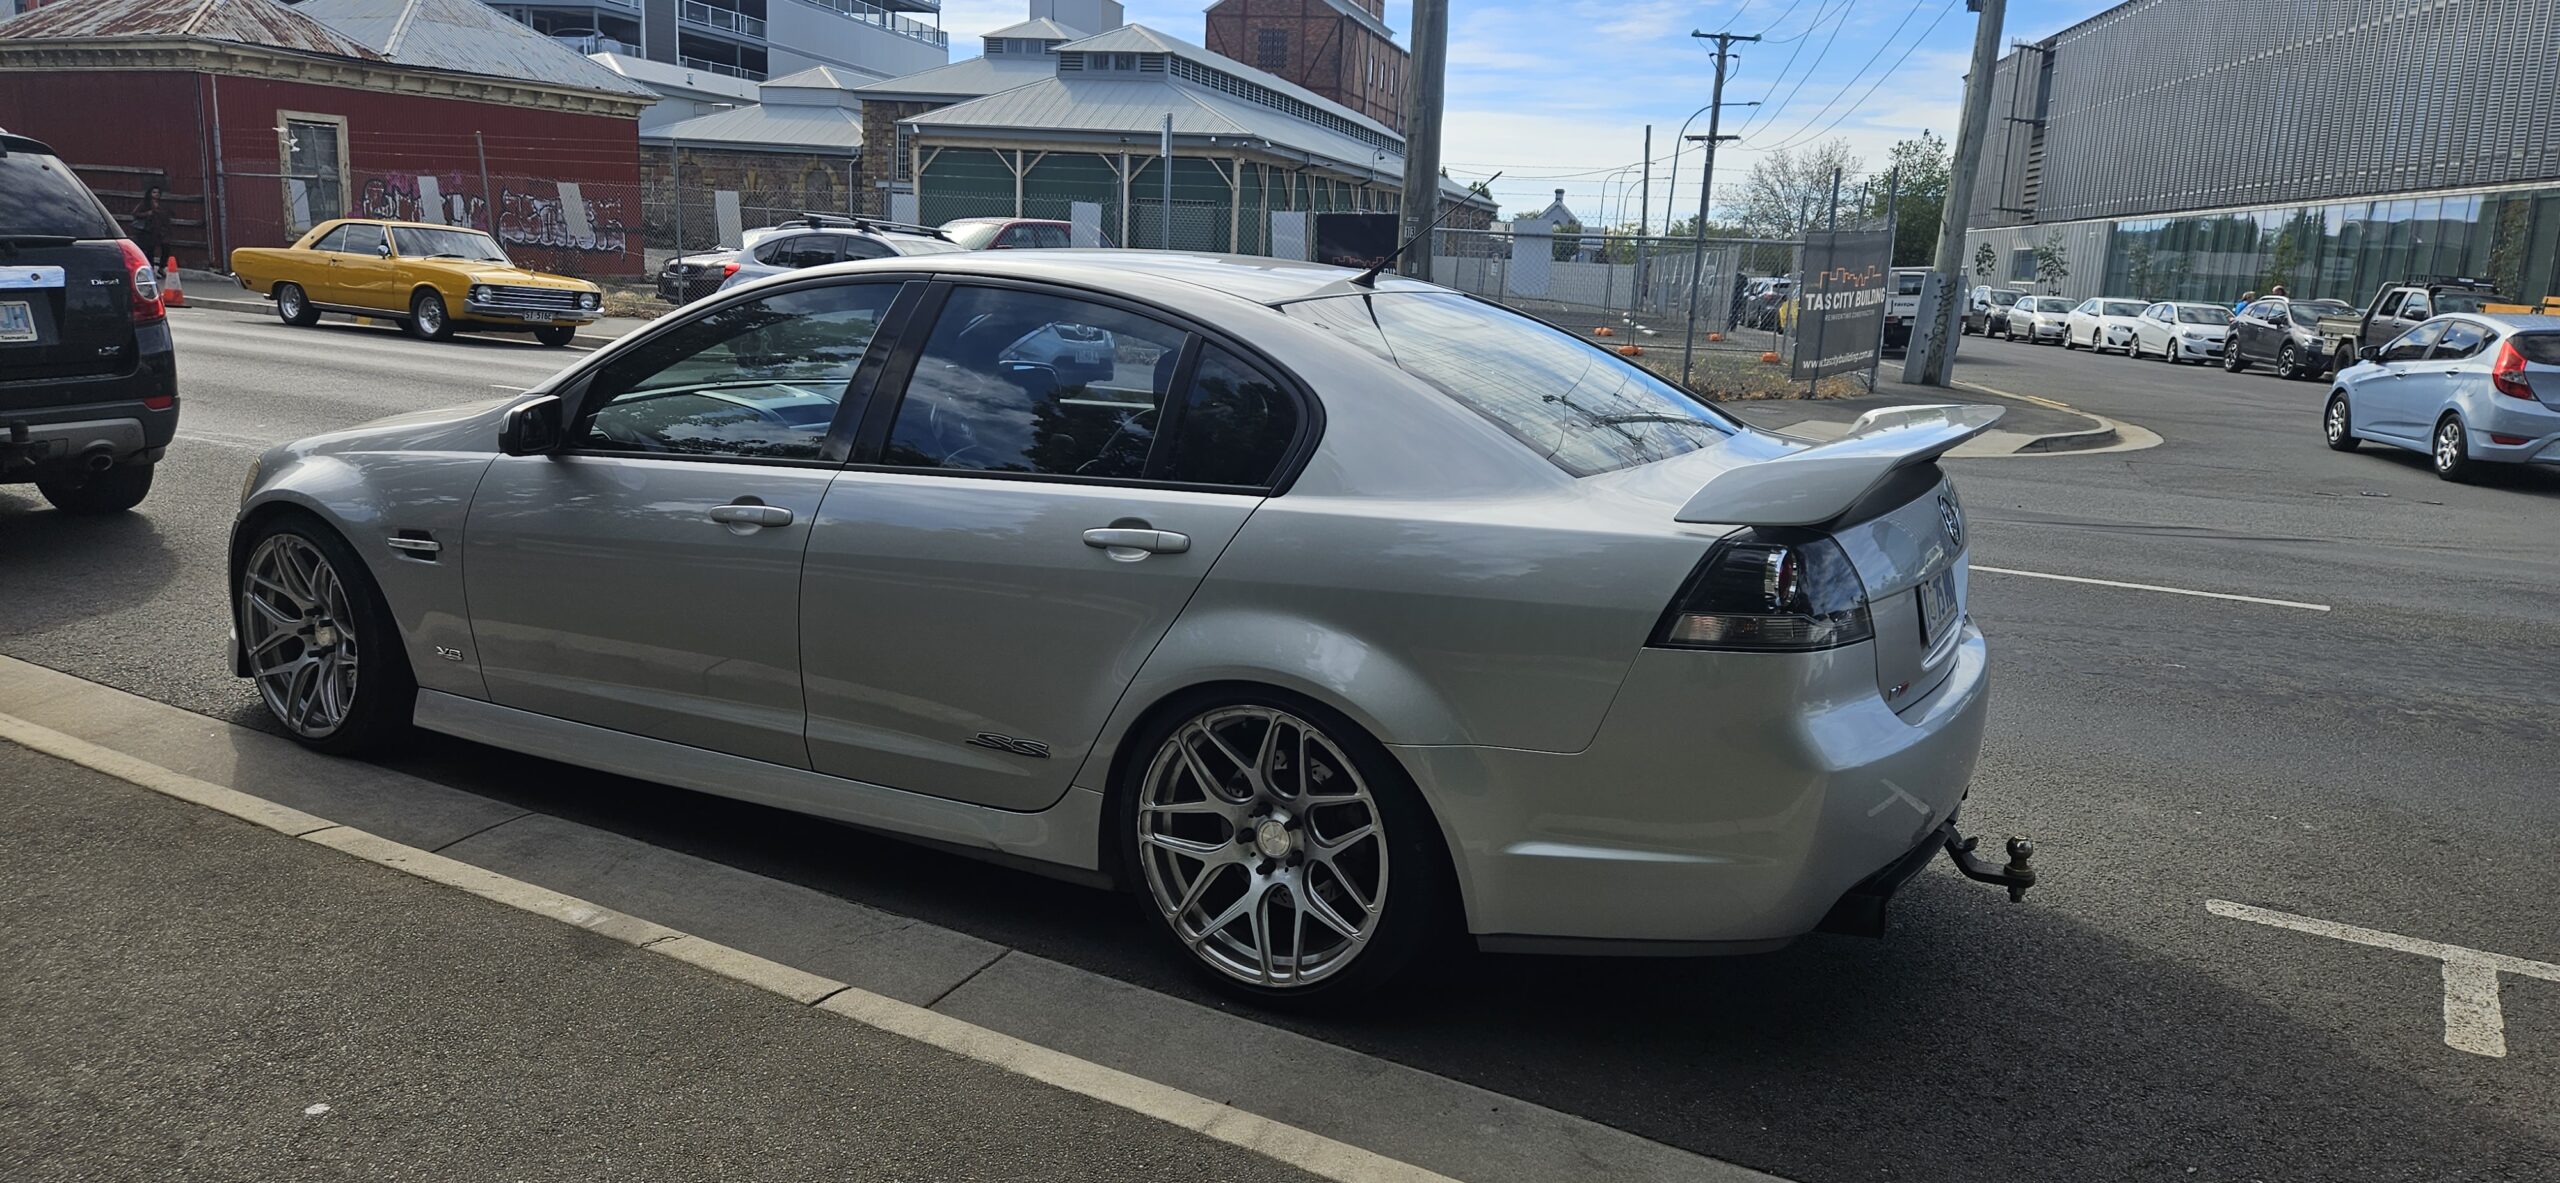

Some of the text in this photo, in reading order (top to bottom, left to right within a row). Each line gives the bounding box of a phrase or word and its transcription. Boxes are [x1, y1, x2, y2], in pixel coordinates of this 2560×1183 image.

[91, 278, 120, 286] Diesel
[1805, 287, 1886, 311] TAS CITY BUILDING
[965, 731, 1050, 759] SS
